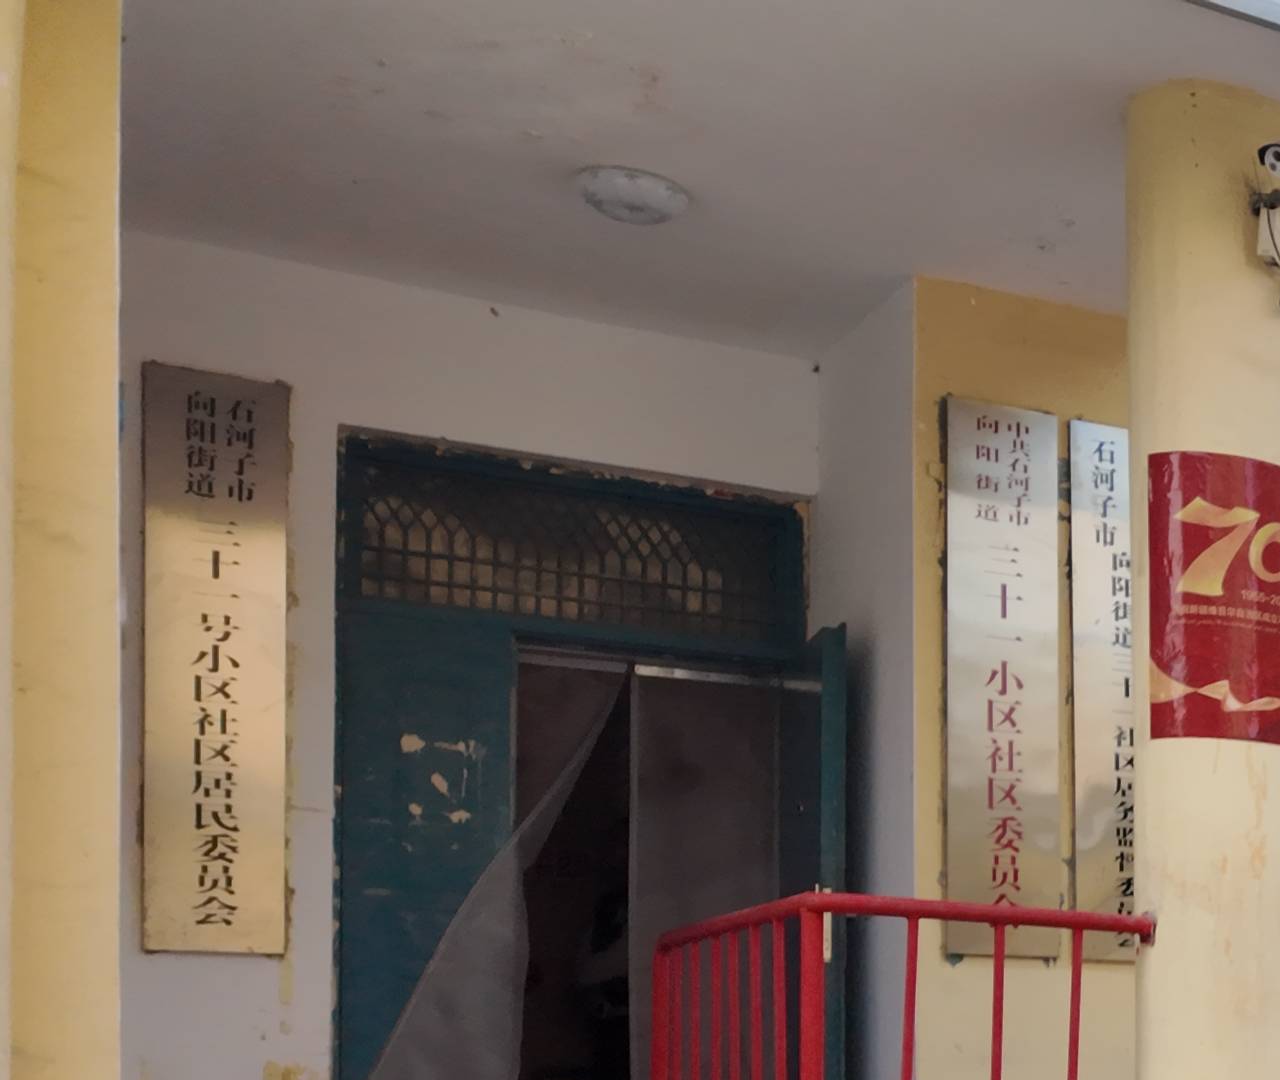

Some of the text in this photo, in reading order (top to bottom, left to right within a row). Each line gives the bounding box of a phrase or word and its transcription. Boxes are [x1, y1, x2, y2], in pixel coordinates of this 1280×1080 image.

[184, 390, 217, 499] 向阳街道
[227, 399, 257, 503] 石河子市
[975, 414, 1000, 523] 向阳街道
[1007, 420, 1032, 527] 中共石河子市
[1092, 440, 1117, 547] 石河子市
[190, 519, 242, 927] 三十一号小区社区居民委员会
